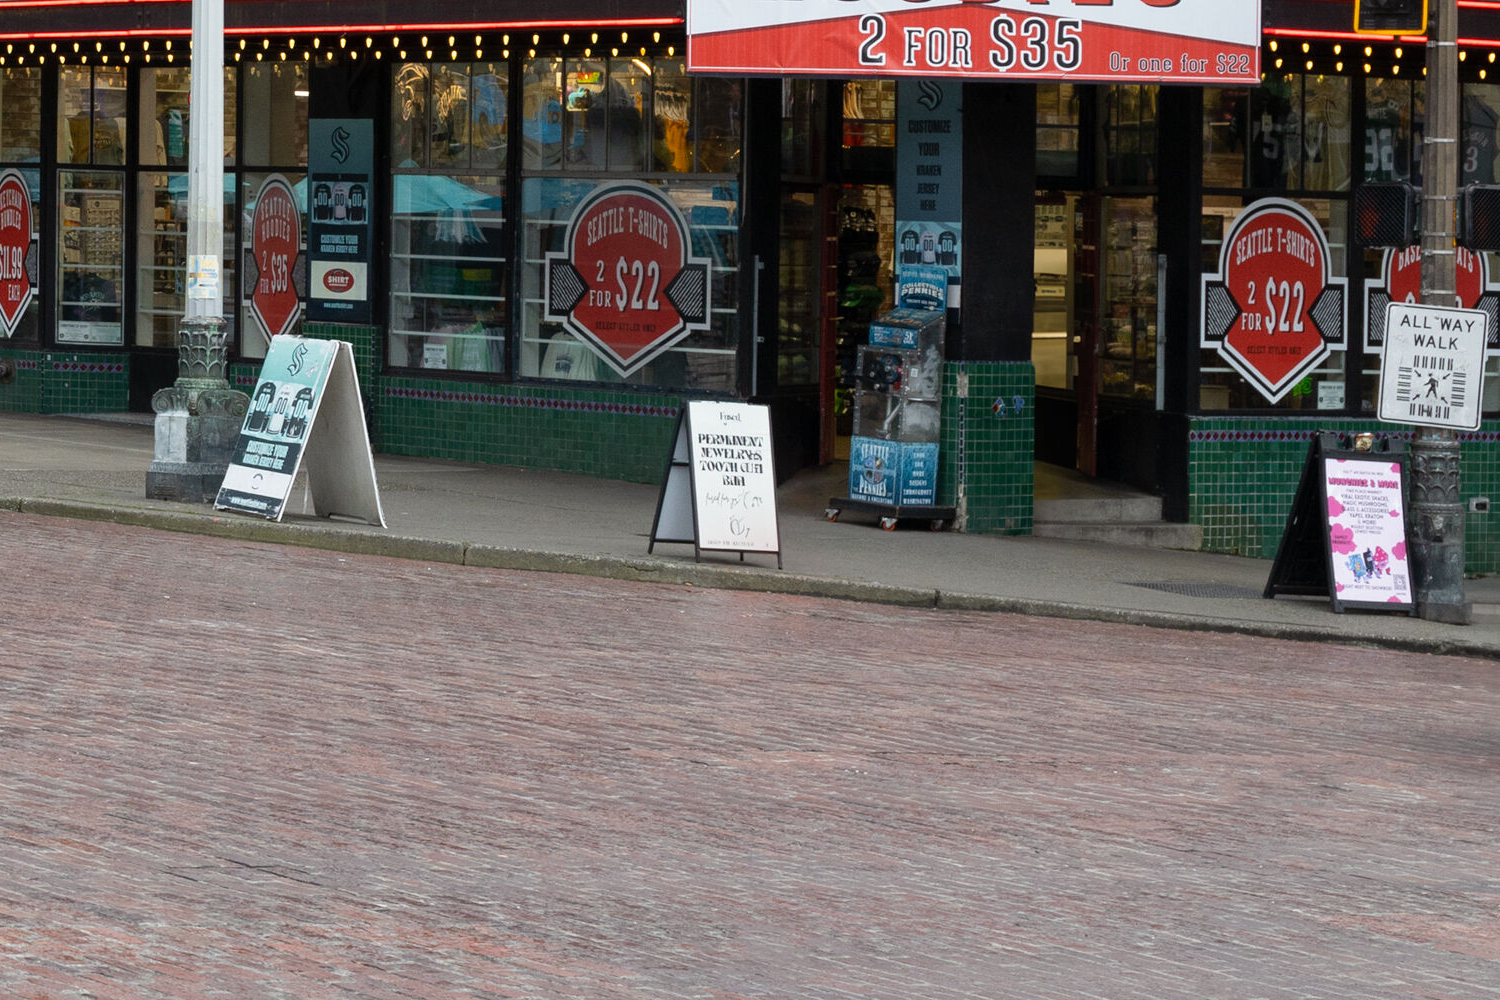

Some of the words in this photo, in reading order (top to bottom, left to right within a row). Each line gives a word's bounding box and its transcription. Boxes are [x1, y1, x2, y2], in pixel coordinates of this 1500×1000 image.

[859, 13, 886, 66] 2
[904, 27, 973, 67] FOR
[990, 13, 1082, 71] $35
[1110, 50, 1130, 72] Or
[1138, 58, 1172, 72] one
[1180, 55, 1208, 73] for
[1216, 55, 1250, 74] $22
[908, 120, 951, 134] CUSTOMIZE
[918, 143, 940, 156] YOUR
[916, 165, 941, 177] KRAKEN
[917, 183, 940, 195] JERSEY
[261, 197, 291, 221] SEATTLE
[920, 200, 936, 211] HERE
[261, 218, 290, 243] HOODIES
[588, 207, 624, 246] SEATTLE
[629, 207, 668, 249] T-SHIRTS
[1236, 228, 1273, 265] SEATTLE
[1277, 228, 1315, 267] T-SHIRTS
[263, 250, 267, 271] 2
[1398, 246, 1421, 272] BASE
[1457, 247, 1473, 273] ATS
[271, 252, 288, 295] $35
[596, 260, 604, 282] 2
[8, 284, 20, 301] EACH
[260, 278, 269, 294] FOR
[615, 256, 660, 312] $22
[1248, 281, 1255, 304] 2
[589, 289, 611, 307] FOR
[901, 287, 944, 300] PENNIES
[1265, 277, 1304, 335] $22
[1241, 312, 1261, 330] FOR
[1401, 315, 1431, 329] ALL
[1439, 319, 1475, 333] WAY
[1414, 333, 1459, 350] WALK
[698, 433, 764, 448] PERMANENT
[700, 460, 738, 473] TOOTH
